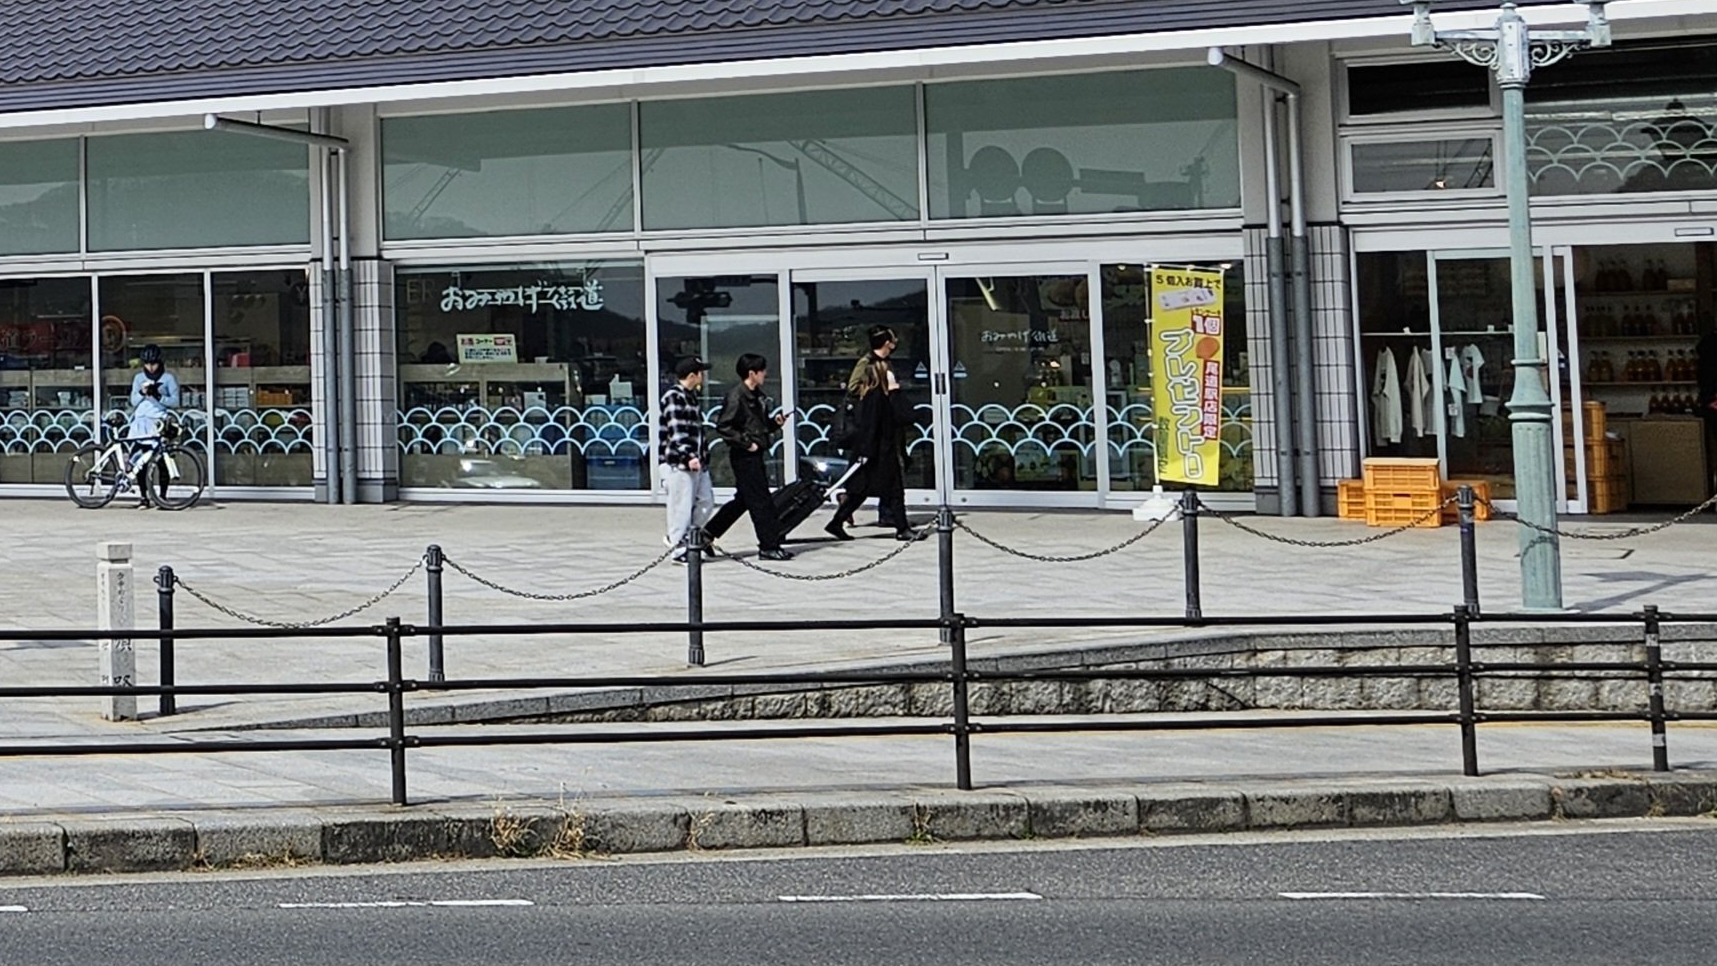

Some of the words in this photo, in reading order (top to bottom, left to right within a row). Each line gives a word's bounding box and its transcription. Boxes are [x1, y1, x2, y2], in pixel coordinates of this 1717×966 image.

[440, 279, 605, 314] おみやげ街道
[1192, 314, 1220, 334] 1個
[1204, 361, 1219, 439] 尾道駅店限定
